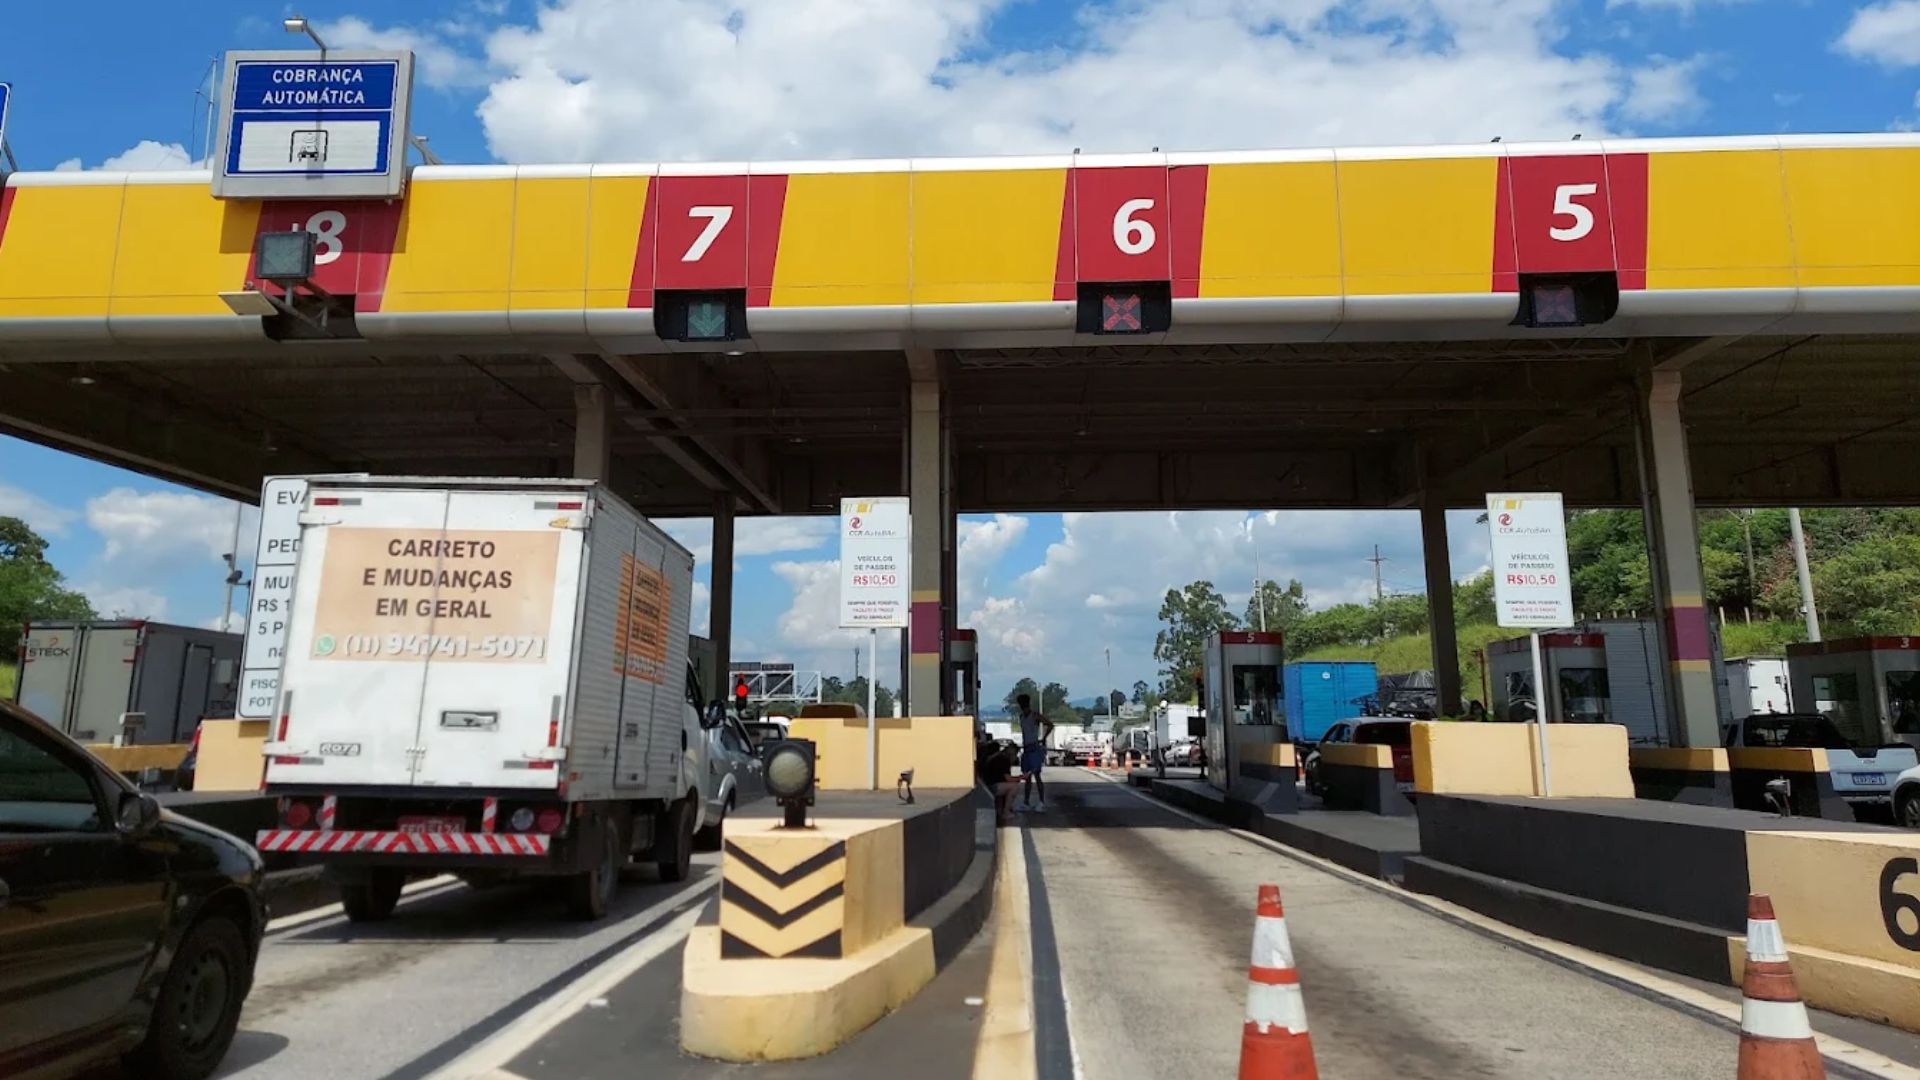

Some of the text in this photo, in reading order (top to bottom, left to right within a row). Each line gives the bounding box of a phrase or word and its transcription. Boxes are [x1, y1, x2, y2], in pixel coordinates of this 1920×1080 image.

[272, 69, 364, 84] COBRANÇA
[262, 87, 365, 105] AUTOMÁTICA
[1549, 183, 1598, 242] 5
[681, 205, 734, 262] 7
[1113, 198, 1156, 255] 6
[305, 210, 347, 266] 8
[388, 538, 496, 559] CARRETO
[363, 568, 513, 592] E MUDANÇAS
[376, 598, 492, 618] EM GERAL
[258, 621, 267, 635] 5
[1247, 632, 1255, 643] 5
[345, 634, 382, 656] (11)
[1573, 635, 1583, 646] 4
[1900, 637, 1909, 648] 3
[1879, 857, 1920, 953] 6
